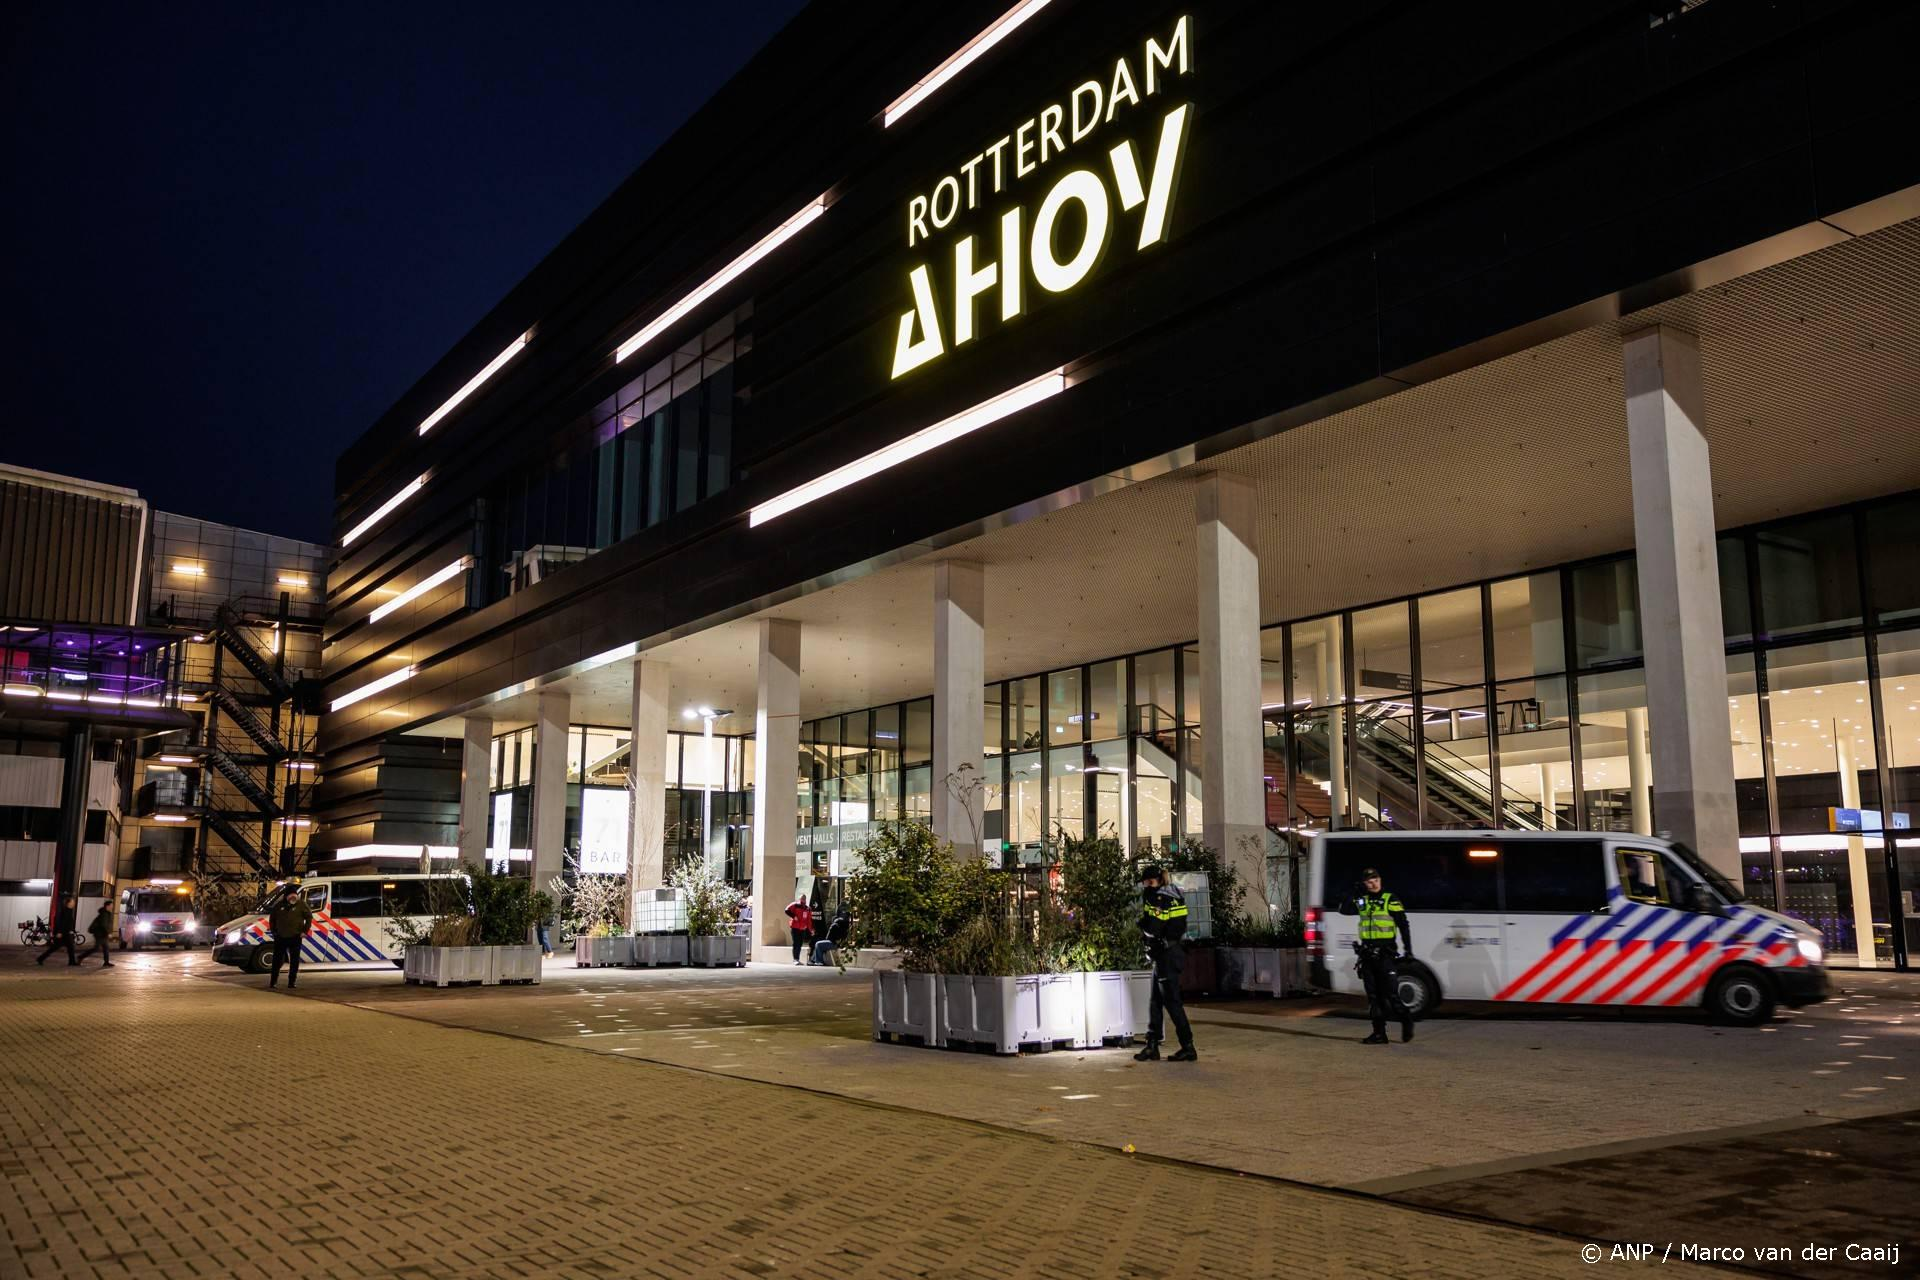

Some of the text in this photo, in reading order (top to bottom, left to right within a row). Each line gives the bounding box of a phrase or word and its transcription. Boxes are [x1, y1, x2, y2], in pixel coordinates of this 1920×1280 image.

[909, 15, 1188, 248] ROTTERDAM
[891, 104, 1189, 381] AHOY
[590, 851, 621, 863] BAR
[796, 833, 812, 846] VENT
[813, 832, 834, 844] HALLS
